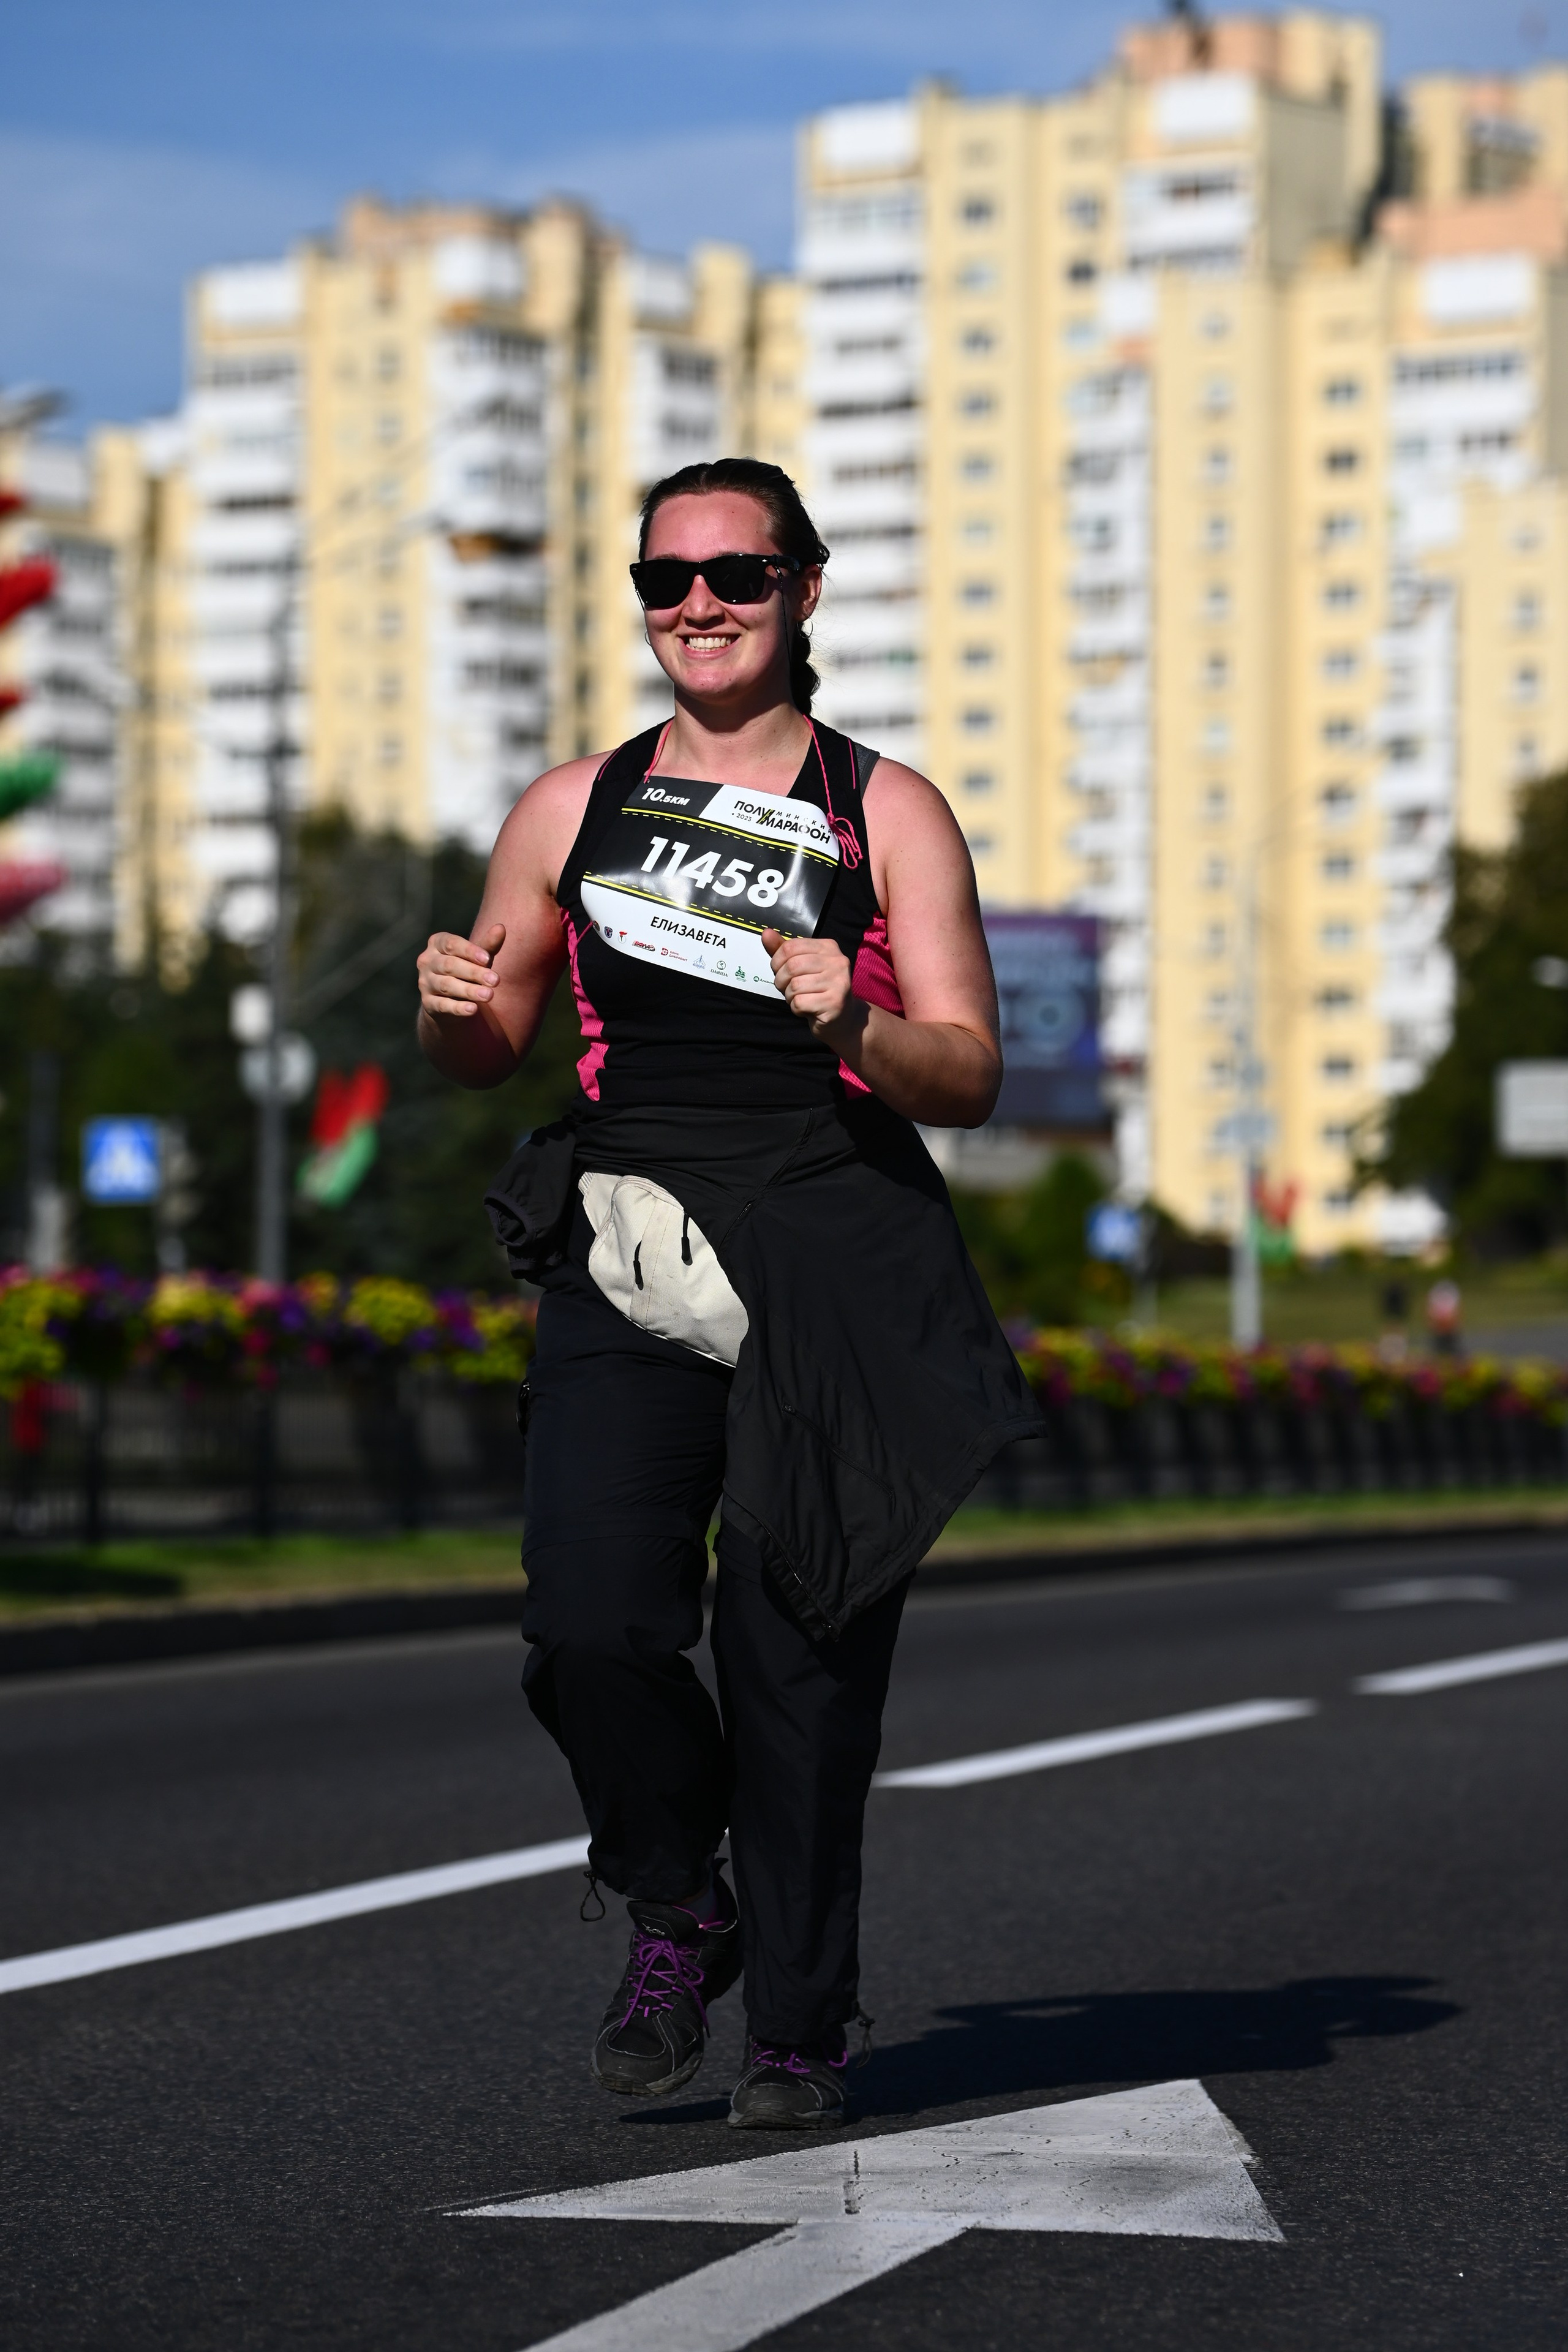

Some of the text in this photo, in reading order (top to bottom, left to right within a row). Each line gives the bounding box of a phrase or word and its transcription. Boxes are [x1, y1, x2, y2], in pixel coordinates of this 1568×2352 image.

[736, 813, 752, 822] 2023
[640, 835, 784, 908] 11458
[650, 916, 726, 949] ЕЛИЗАВЕТА
[710, 968, 728, 977] DARIDA
